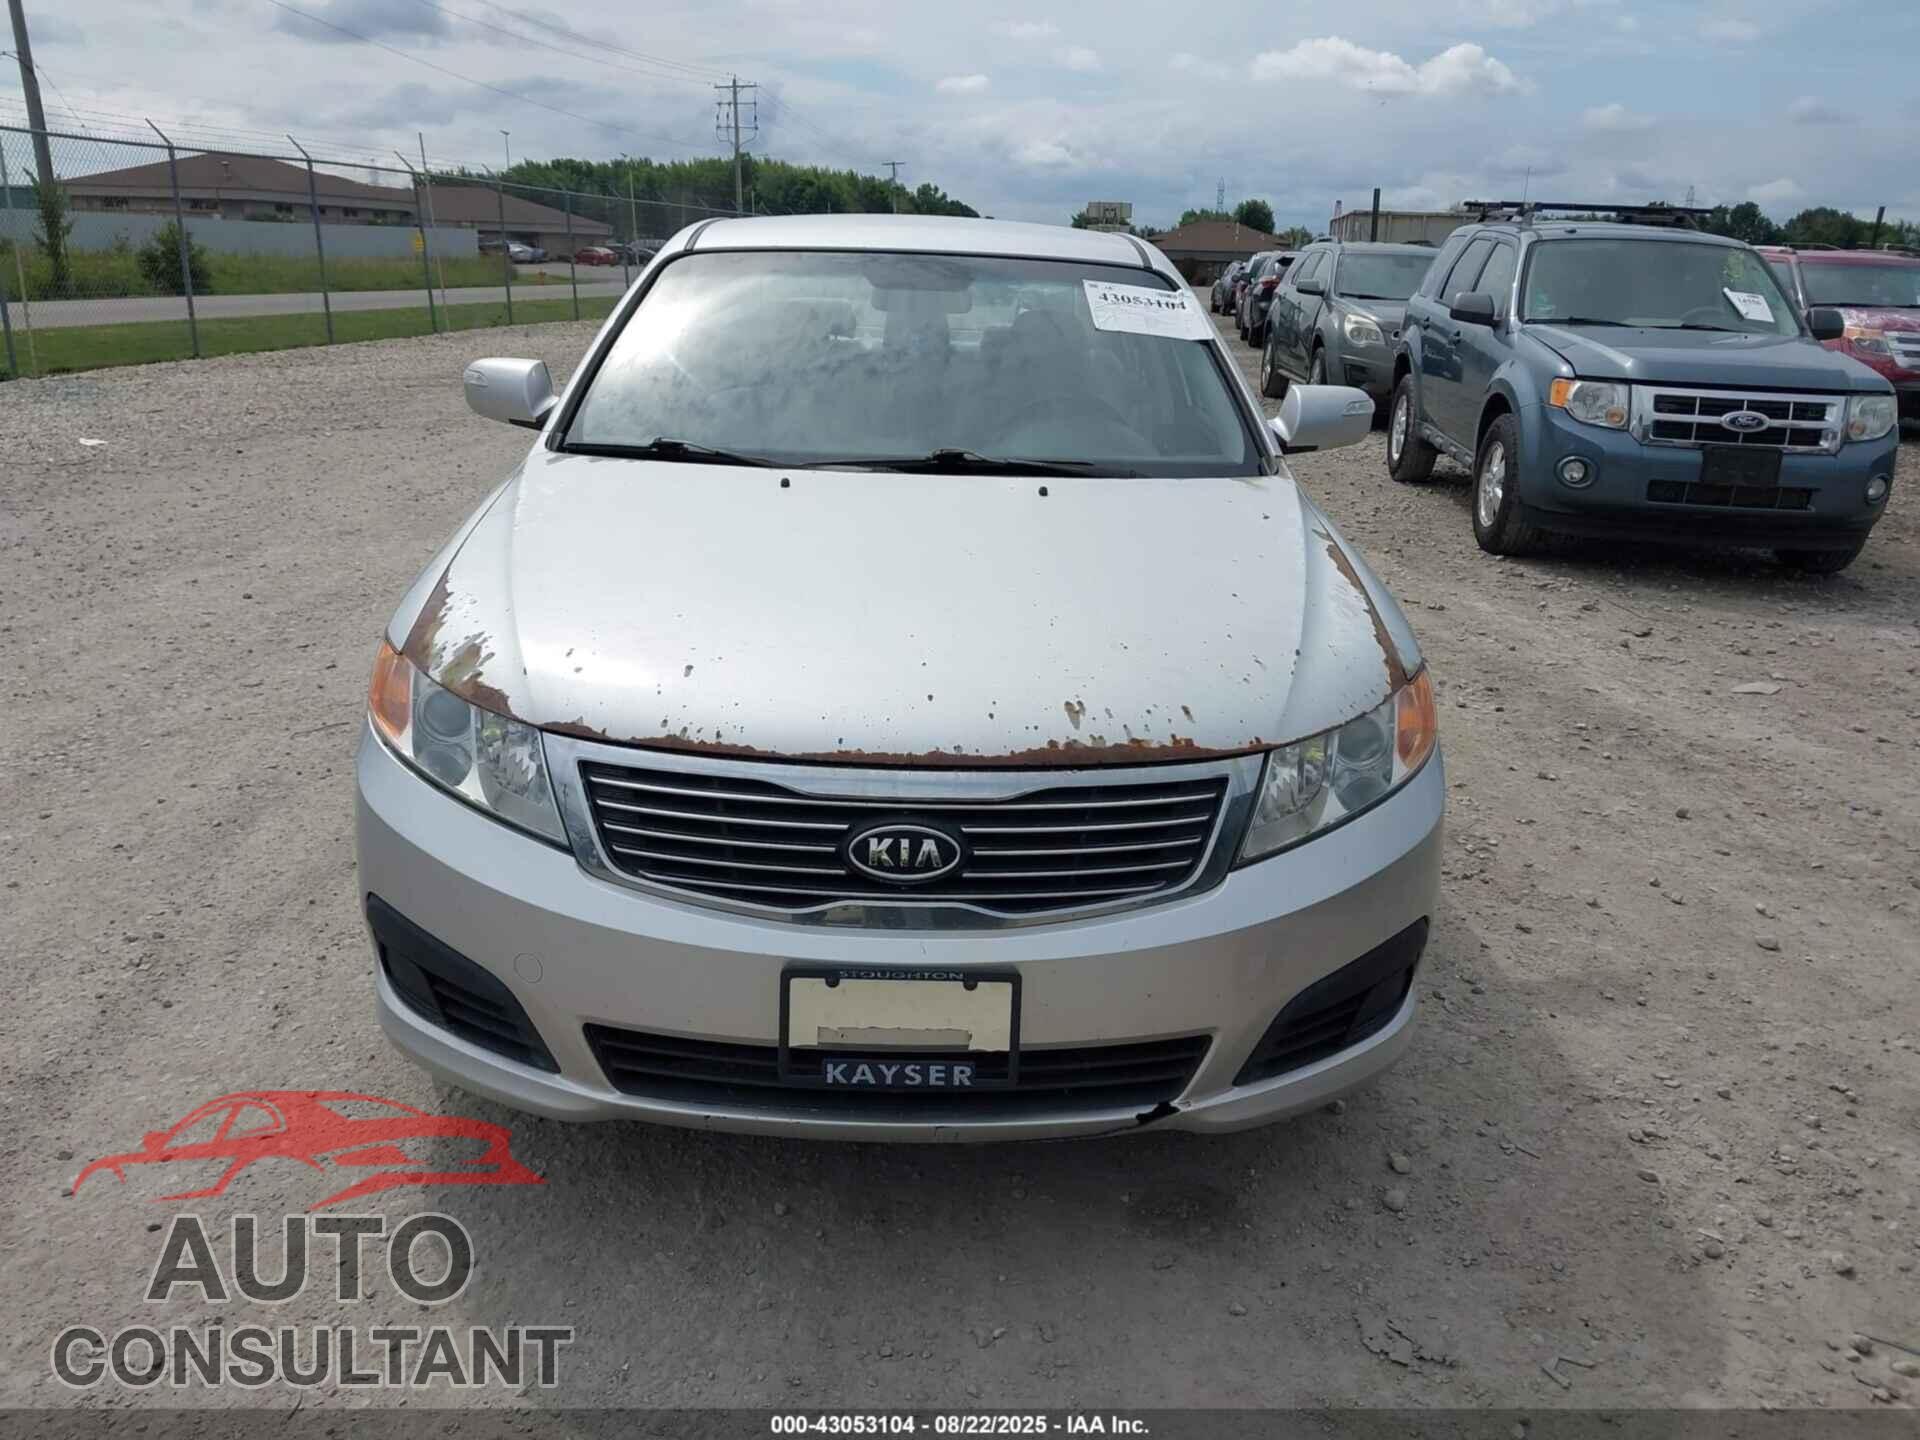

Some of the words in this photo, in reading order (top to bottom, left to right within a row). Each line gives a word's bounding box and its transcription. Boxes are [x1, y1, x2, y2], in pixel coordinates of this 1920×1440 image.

[868, 837, 943, 868] KIA
[839, 970, 964, 980] STOUGHTON
[825, 1063, 974, 1087] KAYSER
